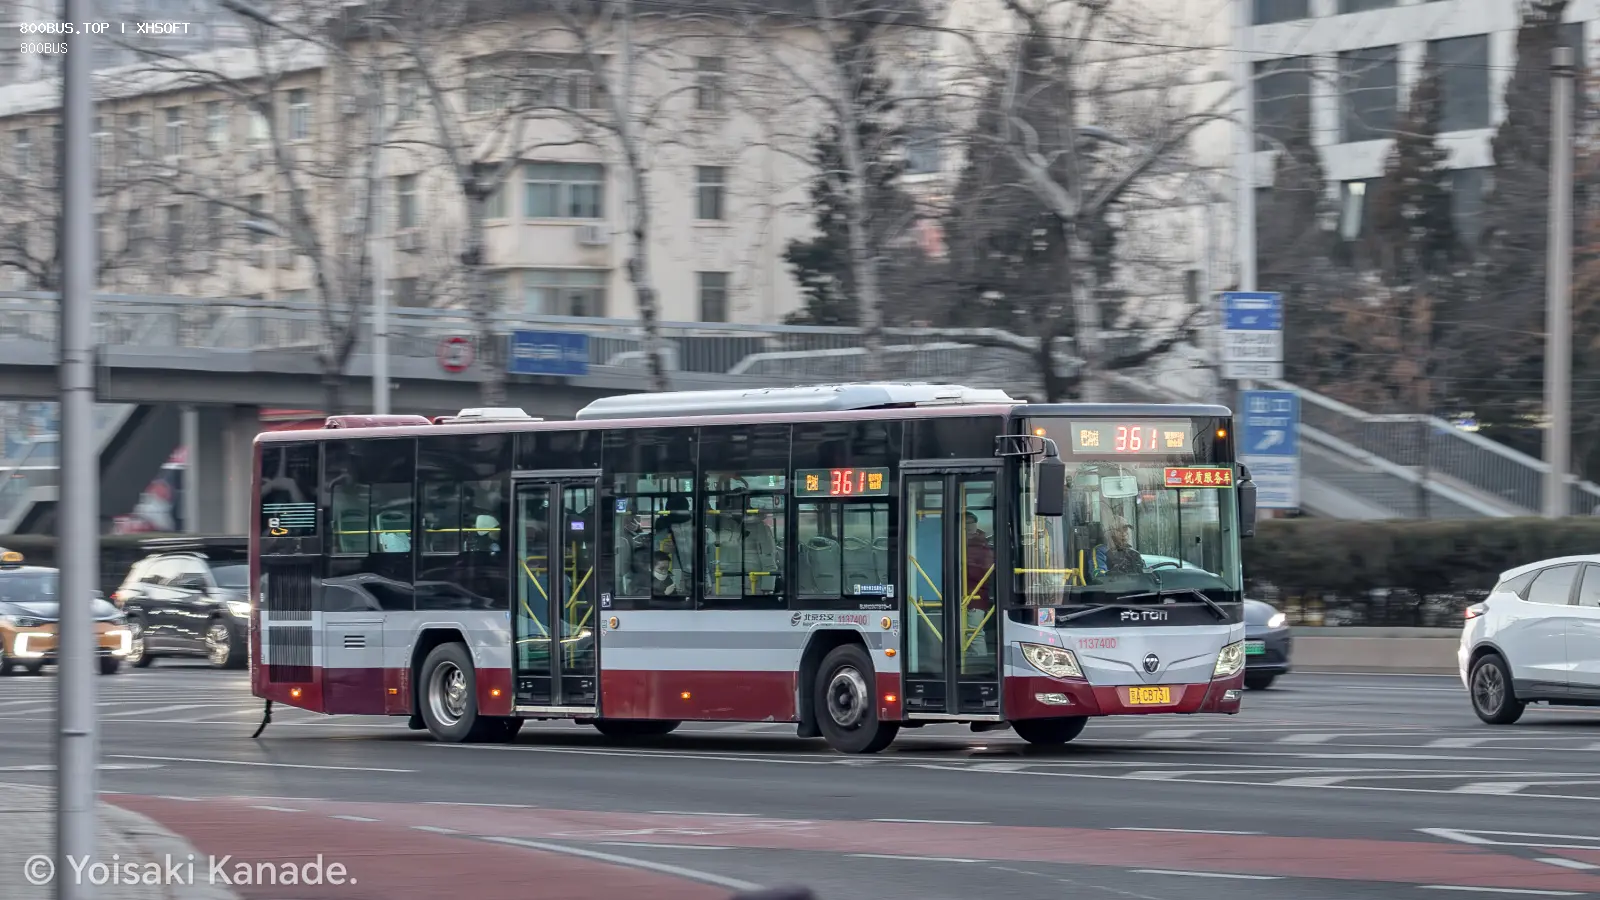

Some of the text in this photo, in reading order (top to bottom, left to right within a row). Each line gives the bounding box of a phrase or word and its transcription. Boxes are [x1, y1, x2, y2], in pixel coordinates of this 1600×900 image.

[1115, 424, 1159, 452] 361
[830, 470, 865, 495] 361
[1184, 470, 1231, 485] 优质服务车
[803, 613, 834, 621] 北京公交
[837, 614, 868, 626] 1137400
[1120, 609, 1168, 621] FOTON
[1078, 637, 1117, 650] 1137400
